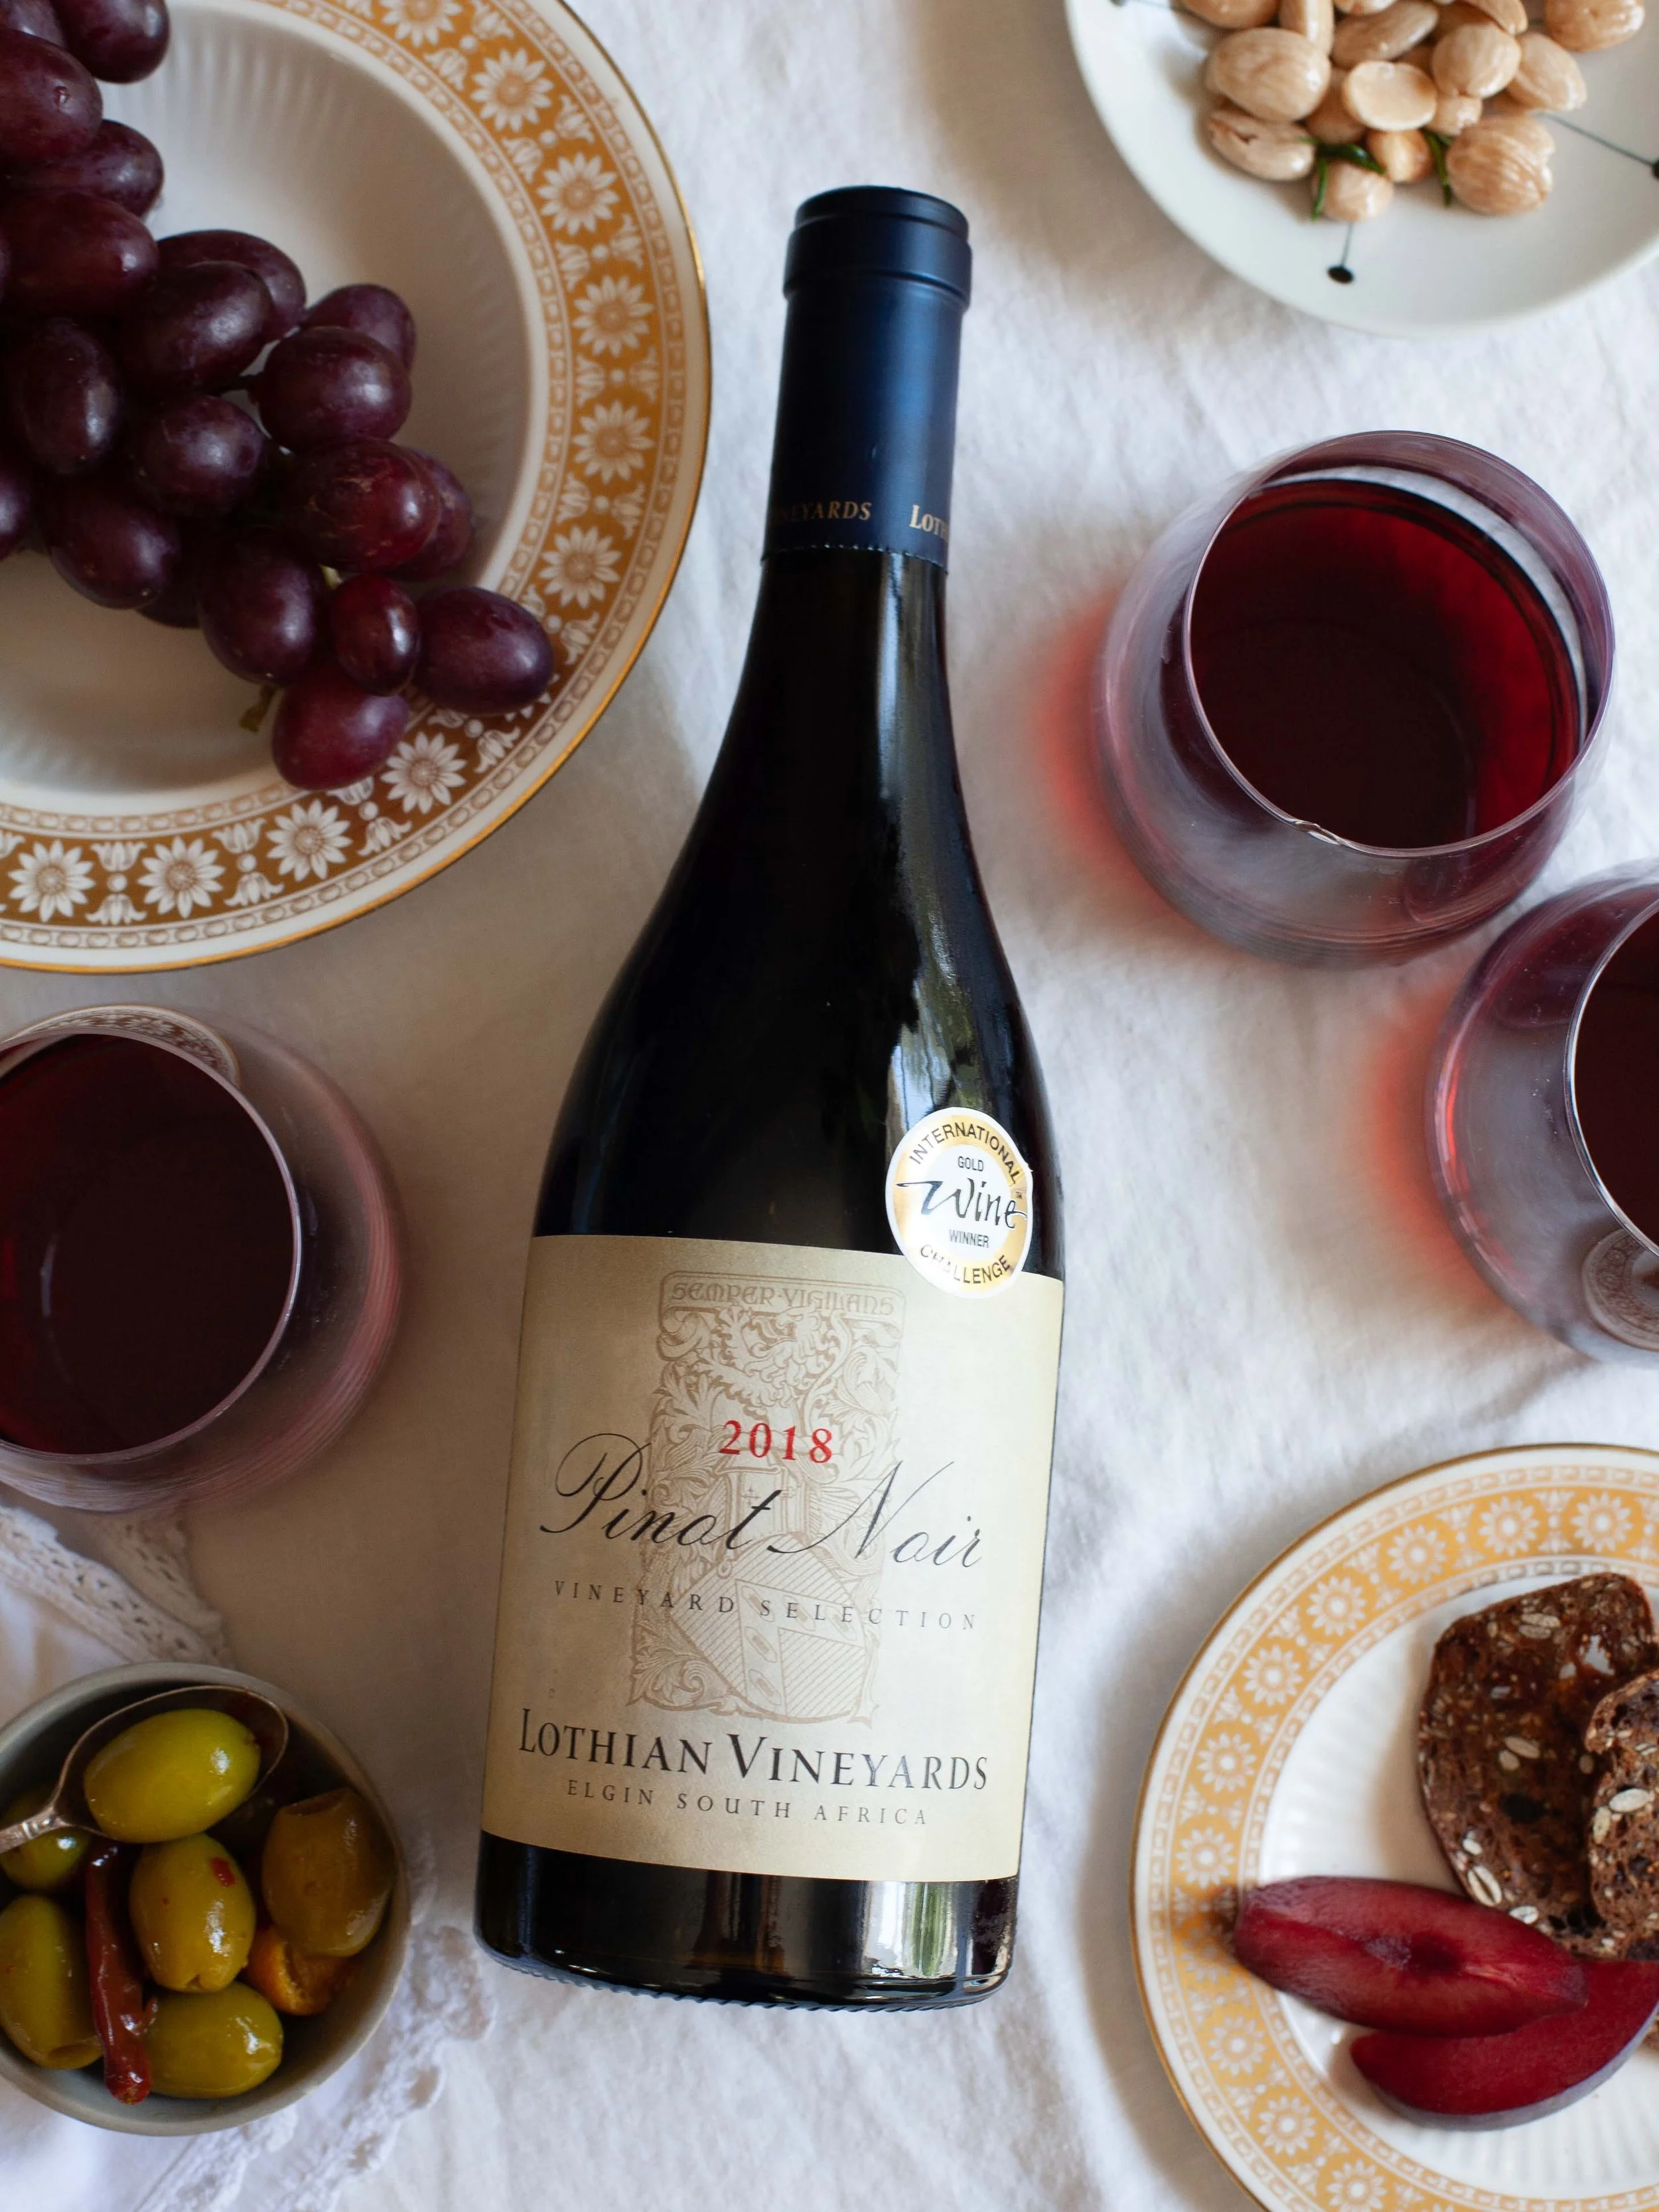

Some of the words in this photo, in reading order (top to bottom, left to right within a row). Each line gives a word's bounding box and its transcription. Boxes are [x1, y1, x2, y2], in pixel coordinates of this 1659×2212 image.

[910, 1122, 1020, 1184] INTERNATIONAL
[958, 1155, 984, 1172] GOLD
[896, 1178, 1027, 1229] Wine
[949, 1229, 989, 1248] WINNER
[920, 1244, 1010, 1284] CHALLENGE
[719, 1420, 833, 1464] 2018
[540, 1433, 782, 1550] Pinot
[767, 1460, 982, 1568] Noir
[553, 1580, 735, 1614] VINEYARD
[760, 1591, 977, 1630] SELECTION
[518, 1708, 713, 1775] LOTHIAN
[728, 1734, 988, 1791] VINEYARDS
[567, 1779, 654, 1805] ELGIN
[677, 1793, 791, 1819] SOUTH
[814, 1805, 927, 1825] AFRICA
